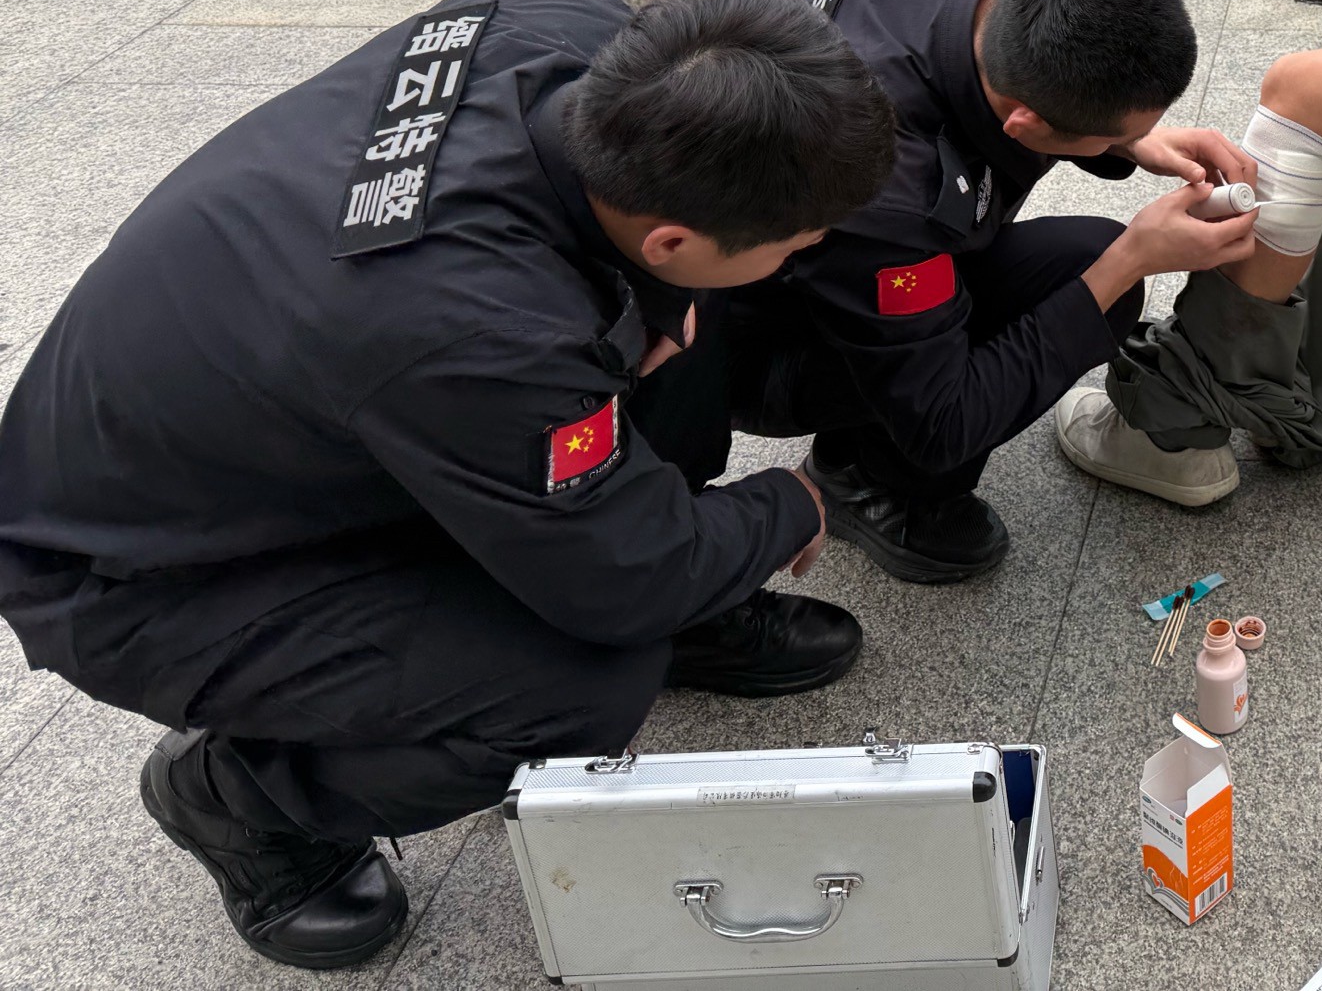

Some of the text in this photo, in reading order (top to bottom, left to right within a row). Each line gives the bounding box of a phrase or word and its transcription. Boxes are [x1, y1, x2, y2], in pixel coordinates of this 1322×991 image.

[343, 16, 486, 227] 缙云特警
[588, 449, 621, 479] CHINESE
